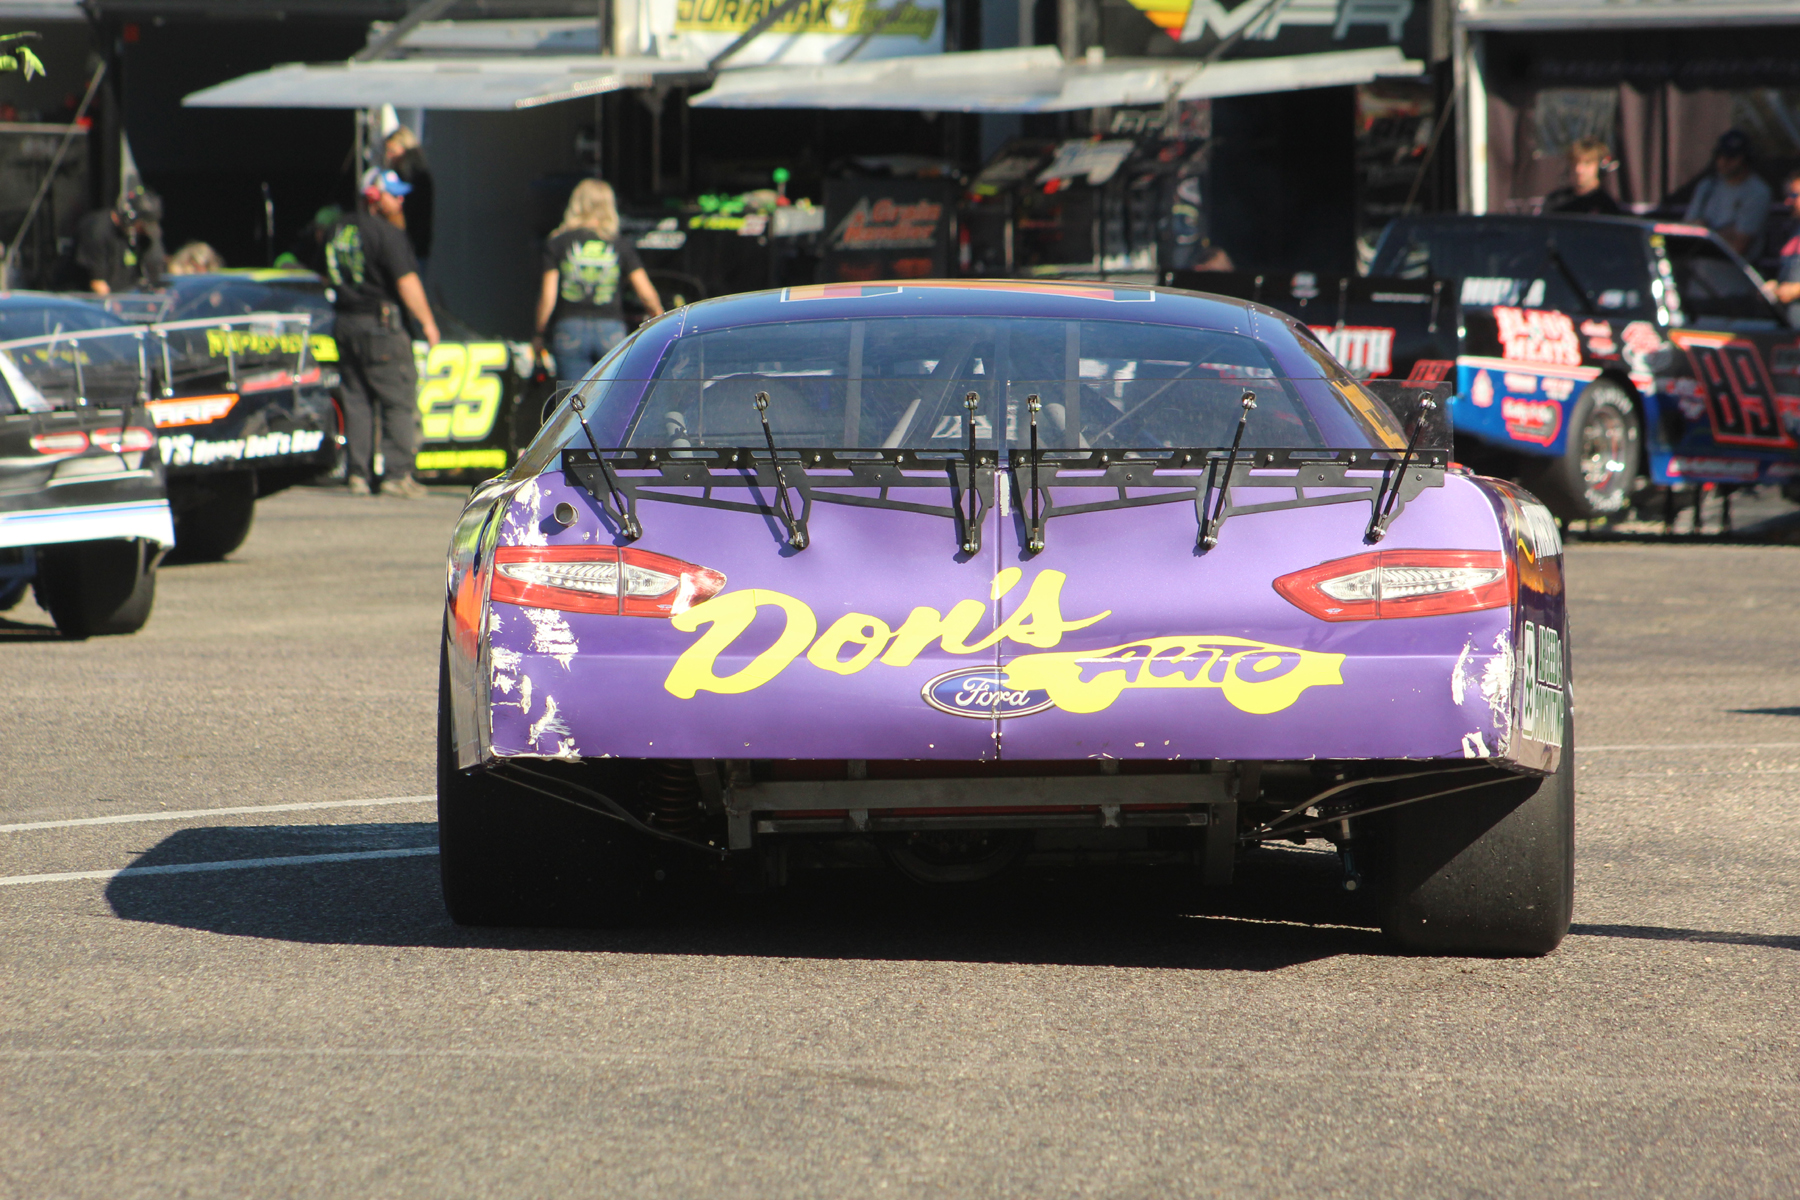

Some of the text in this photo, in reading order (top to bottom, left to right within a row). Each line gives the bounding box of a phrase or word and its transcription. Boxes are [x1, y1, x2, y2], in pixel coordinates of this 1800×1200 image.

[417, 342, 510, 442] 25
[1311, 328, 1391, 374] MITH
[1680, 342, 1788, 442] 89
[664, 567, 1112, 699] Don's
[954, 676, 1031, 707] Ford
